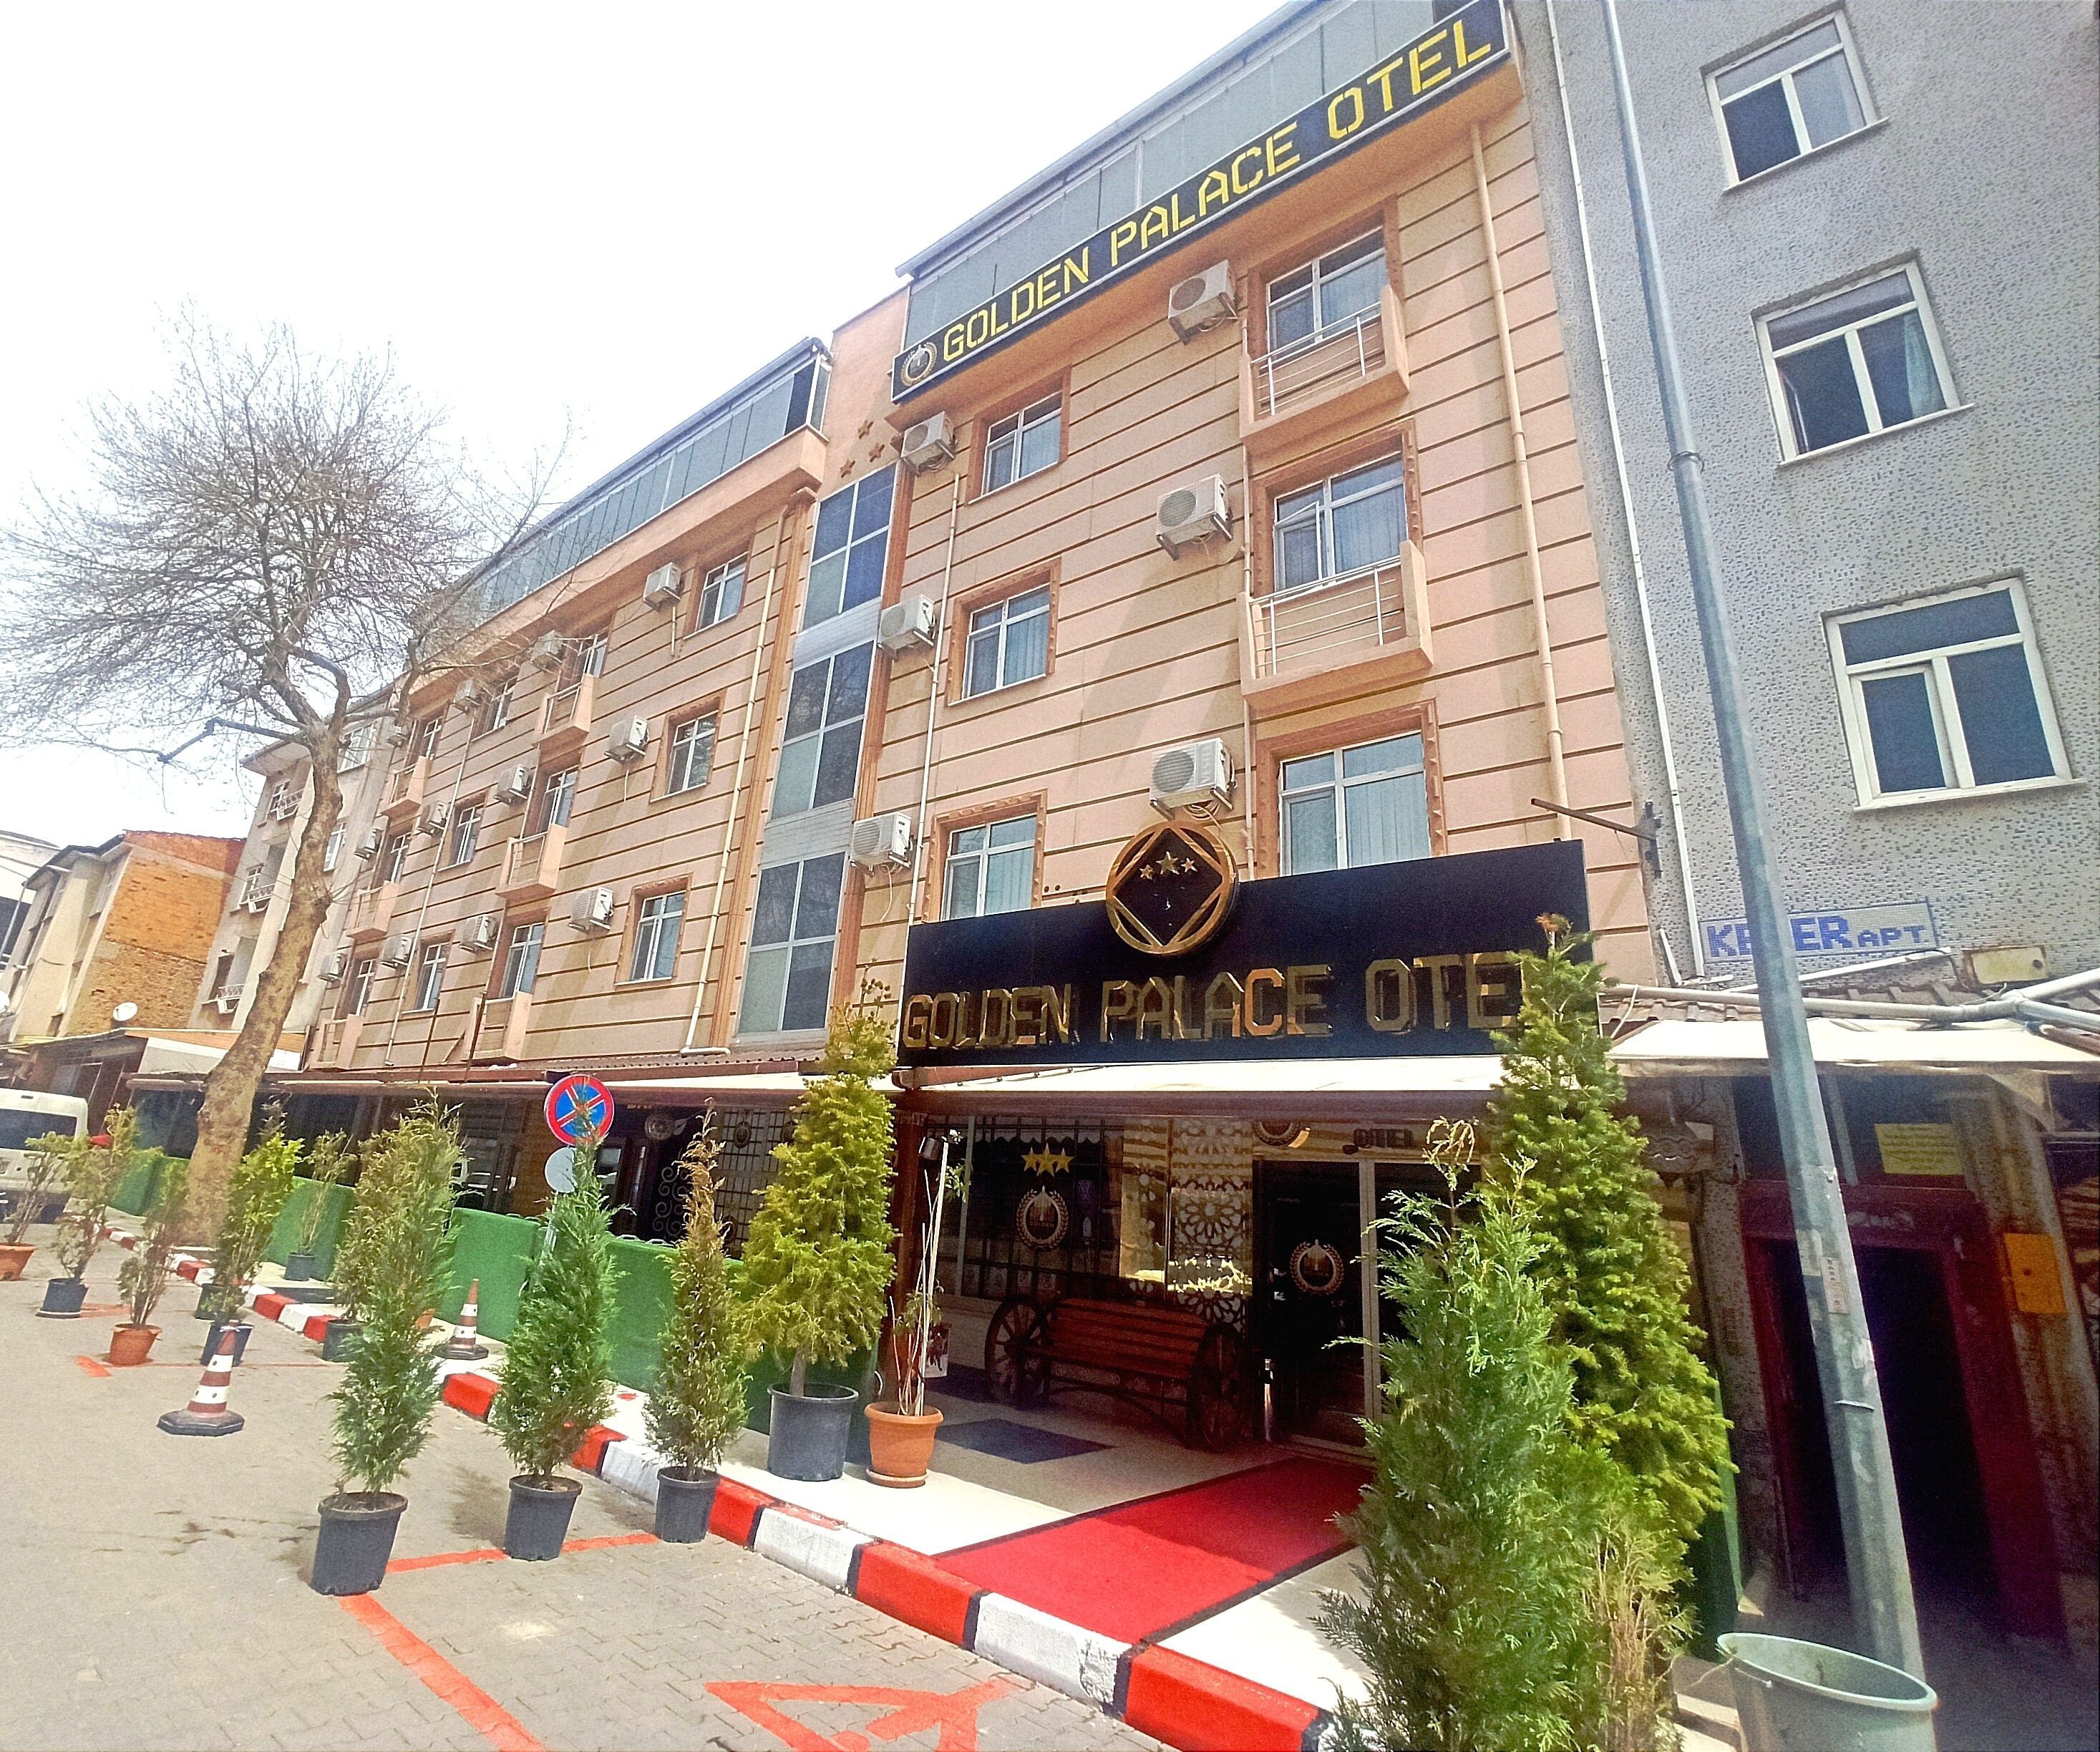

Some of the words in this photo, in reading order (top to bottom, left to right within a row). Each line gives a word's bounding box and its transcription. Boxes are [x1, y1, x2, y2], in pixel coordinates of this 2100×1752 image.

[943, 245, 1090, 363] GOLDEN
[1110, 121, 1301, 267] PALACE
[1327, 19, 1492, 141] OTEL
[1706, 915, 1853, 958] KEER
[1857, 924, 1926, 948] APT
[902, 983, 1072, 1048] GOLDEN
[1099, 965, 1331, 1043] PALACE
[1364, 951, 1532, 1032] OTE
